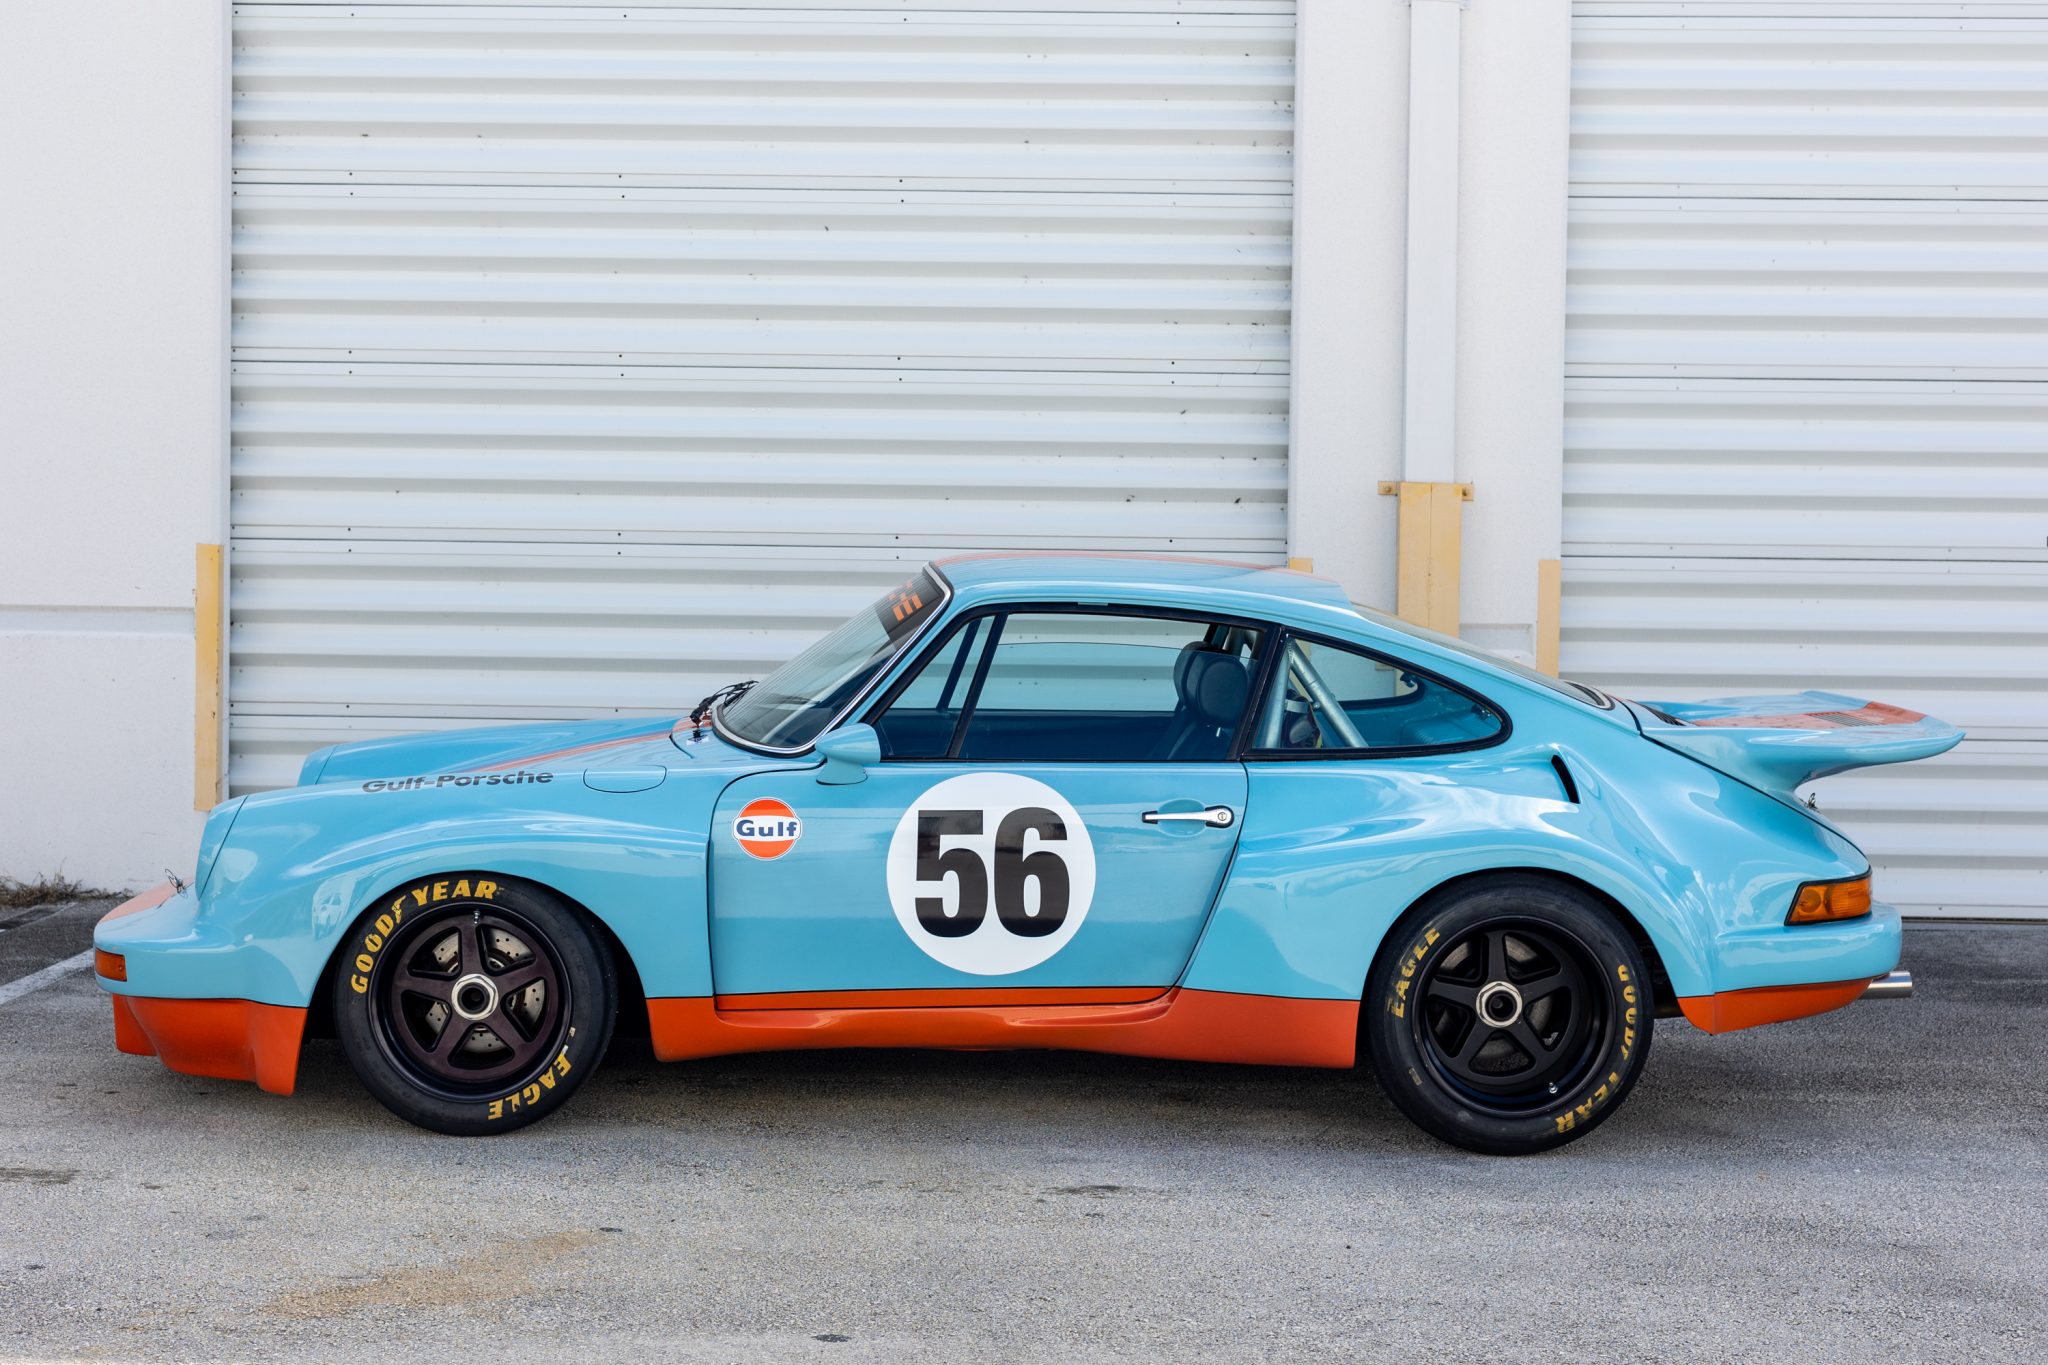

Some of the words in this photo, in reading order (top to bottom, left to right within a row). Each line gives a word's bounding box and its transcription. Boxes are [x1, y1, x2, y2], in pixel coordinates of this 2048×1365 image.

[362, 771, 553, 793] Gulf-Porsche
[736, 819, 798, 837] Gulf
[915, 807, 1070, 938] 56
[488, 1052, 572, 1120] EAGLE
